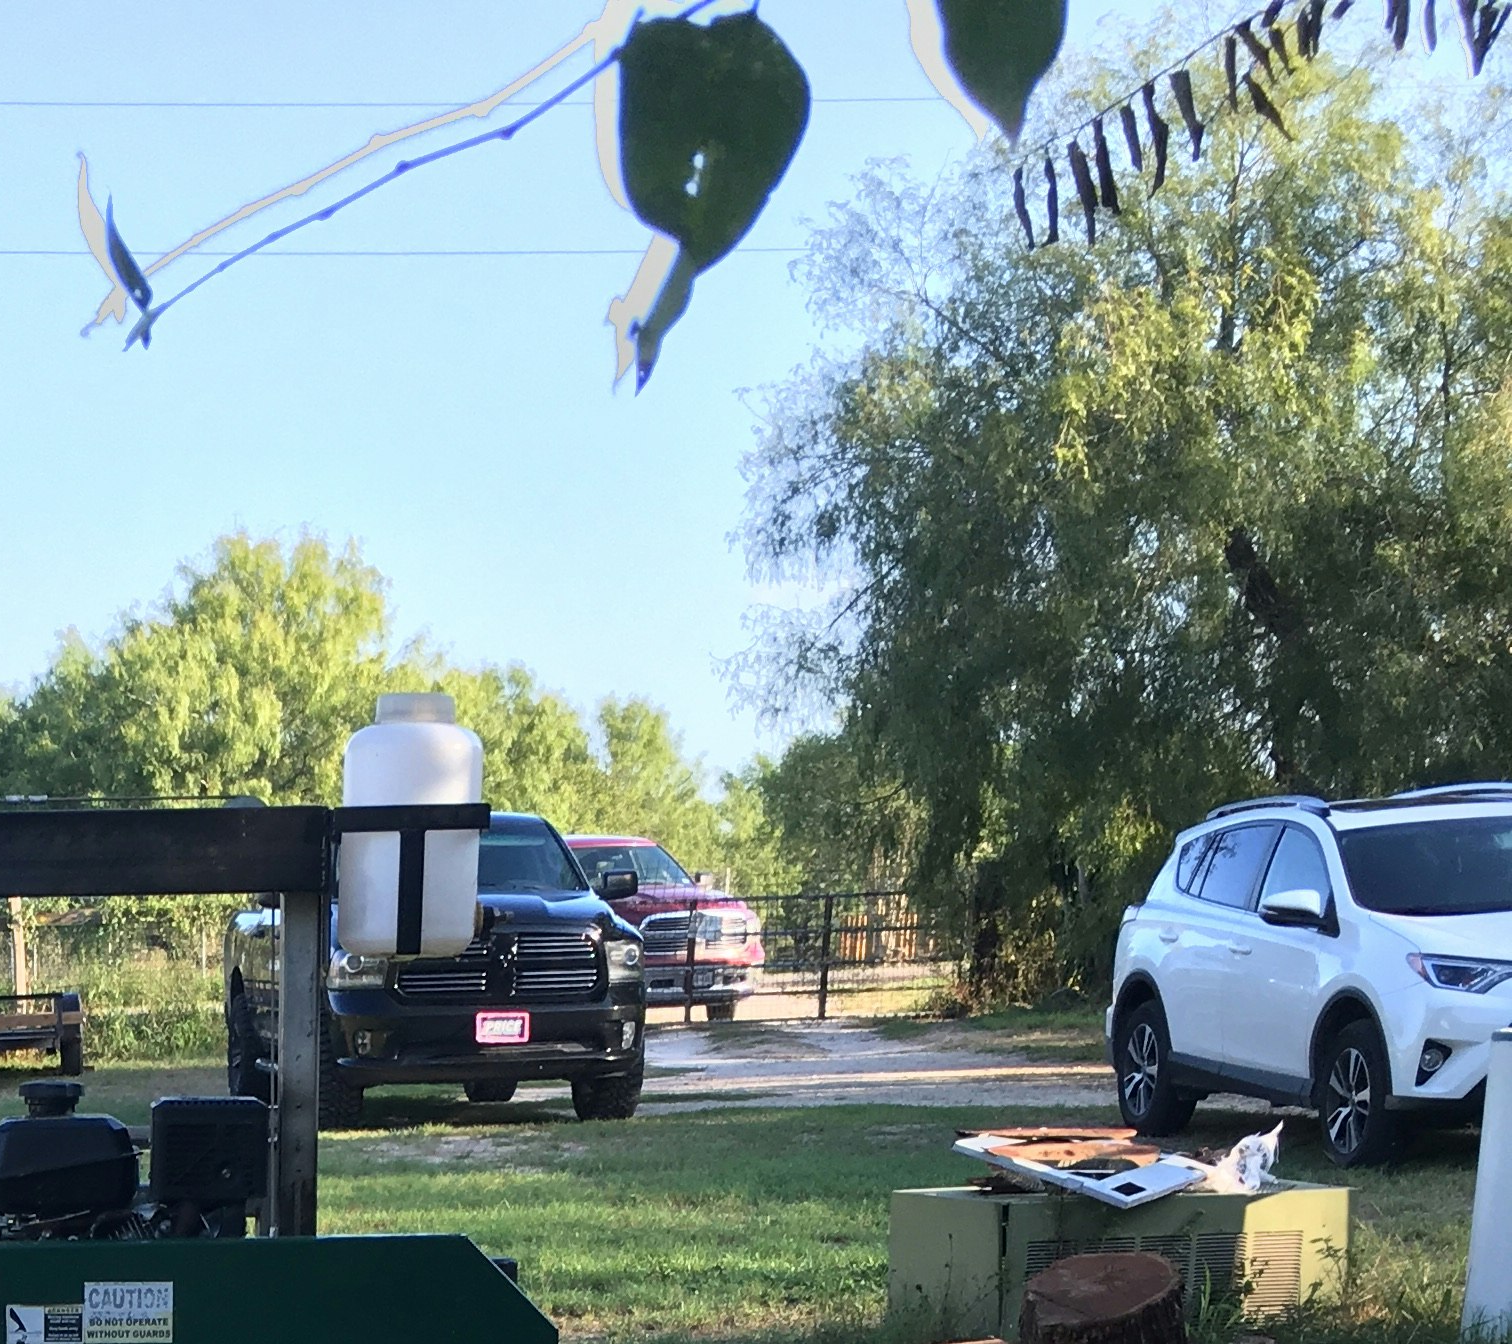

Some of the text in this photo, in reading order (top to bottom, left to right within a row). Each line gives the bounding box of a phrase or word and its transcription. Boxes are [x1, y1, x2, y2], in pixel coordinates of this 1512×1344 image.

[88, 1287, 170, 1309] CAUTION
[89, 1317, 169, 1327] DO NOT OPERATE
[87, 1329, 171, 1339] WITHOUT GUARDS
